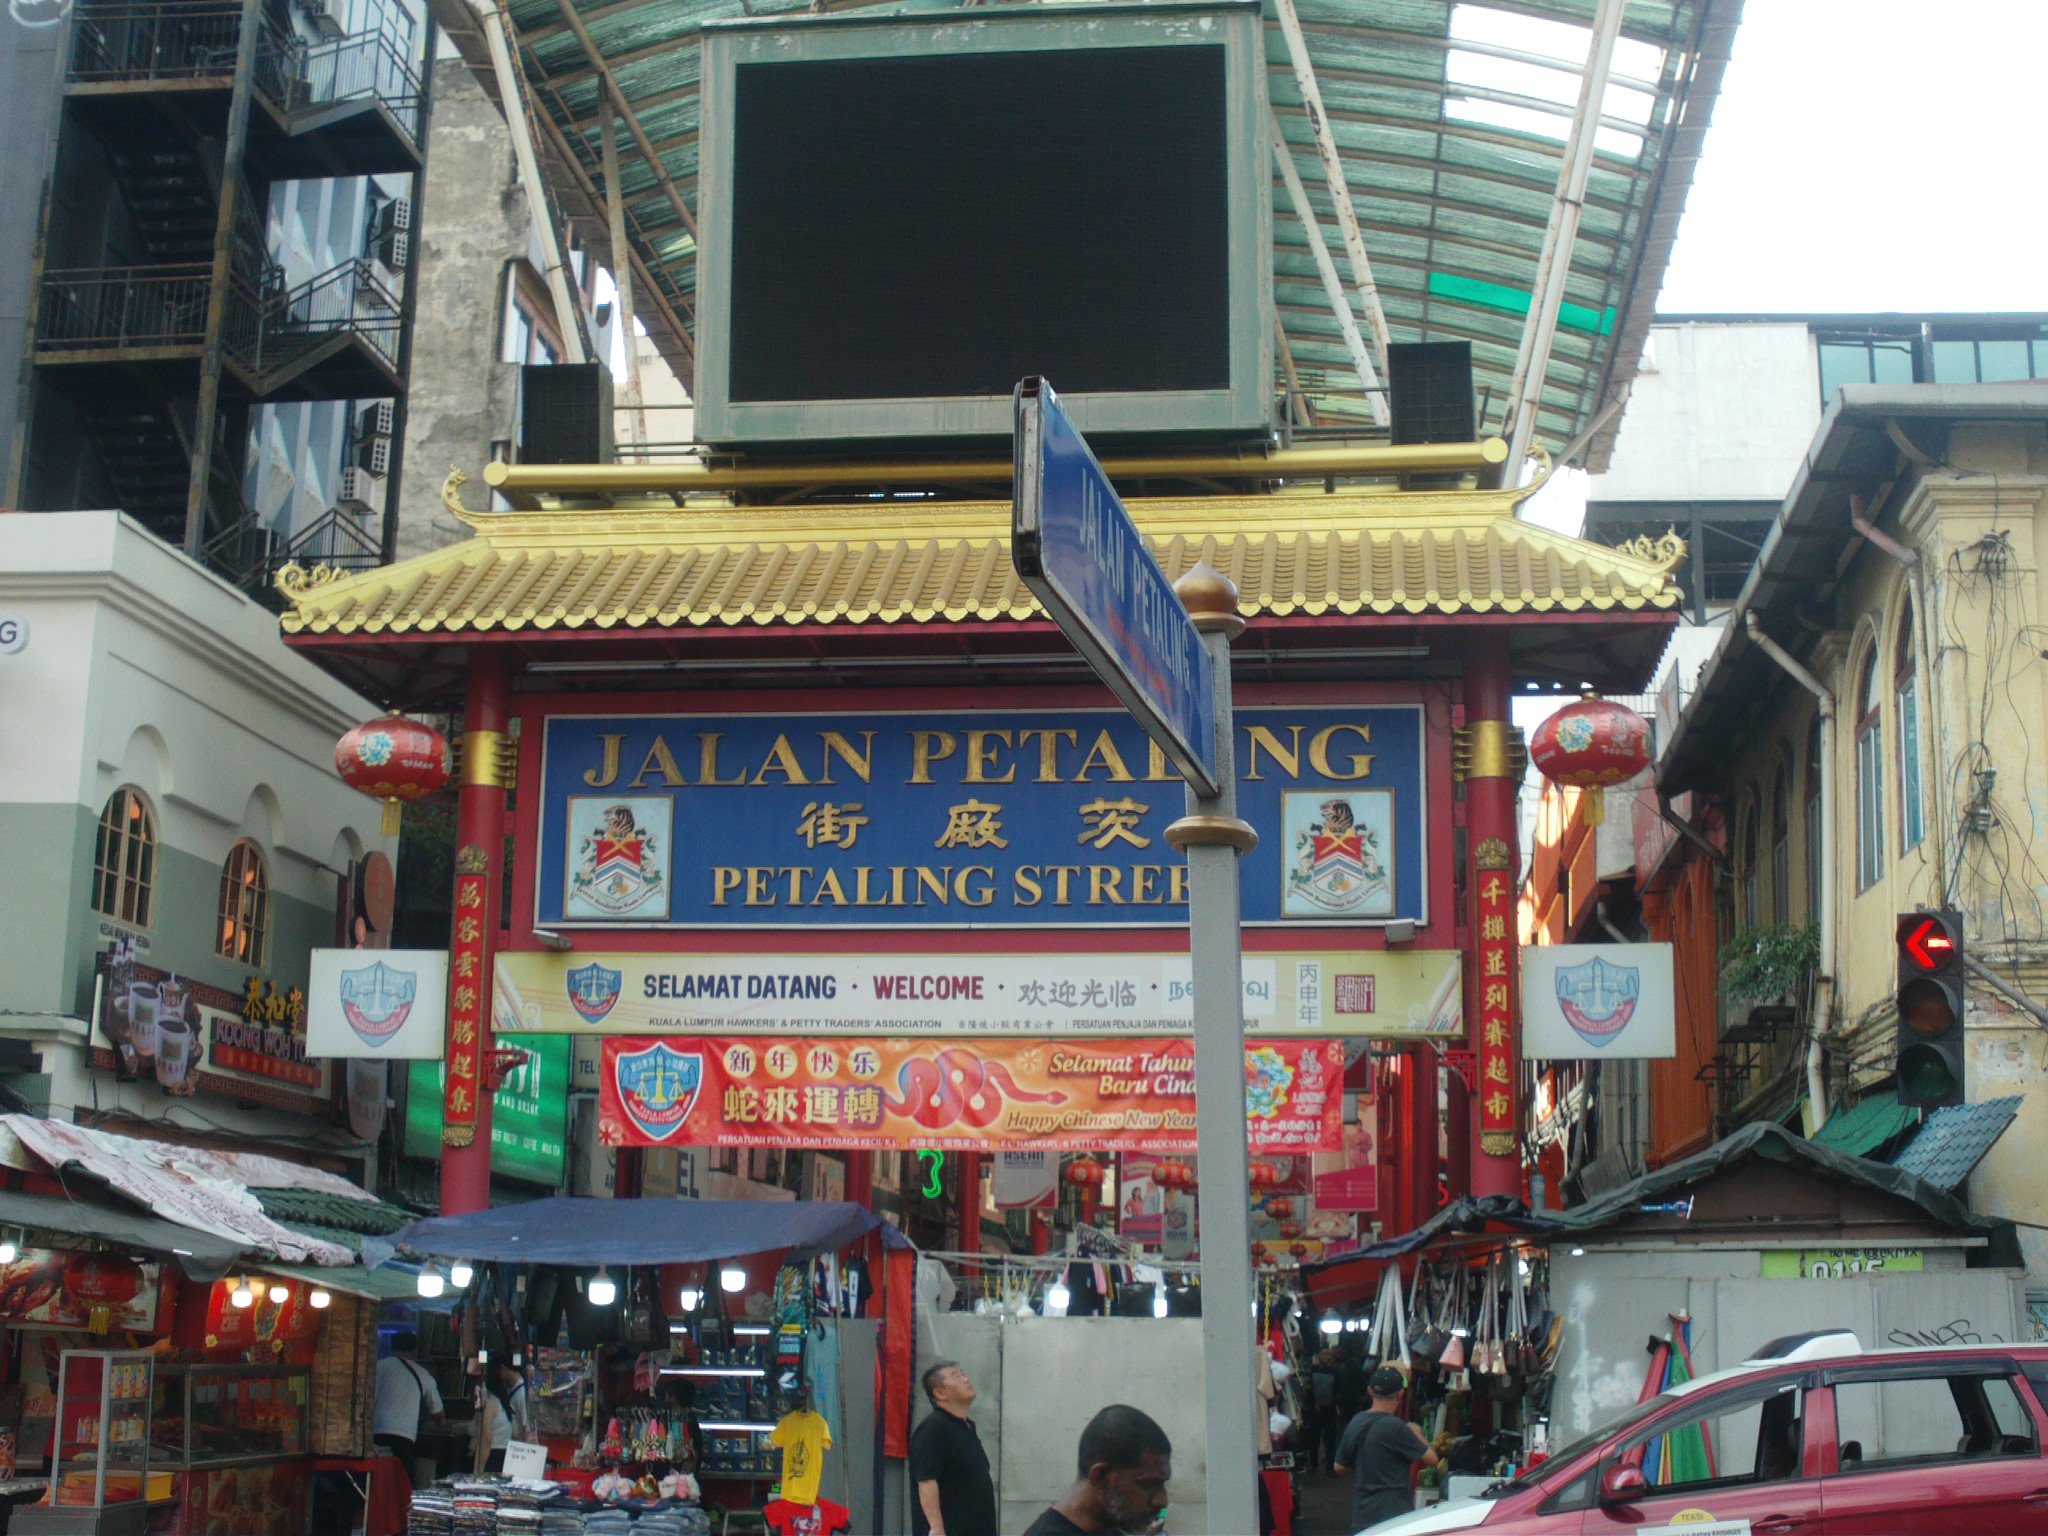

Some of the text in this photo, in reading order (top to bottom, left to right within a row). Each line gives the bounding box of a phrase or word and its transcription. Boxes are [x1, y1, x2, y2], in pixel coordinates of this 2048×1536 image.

[1080, 468, 1126, 602] JALAN
[1133, 548, 1191, 692] PETALING
[582, 723, 1377, 789] JALAN PETALNG
[709, 864, 1190, 907] PETALING STREE
[643, 974, 743, 999] SELAMAT
[747, 974, 837, 999] DATANG
[872, 974, 984, 1000] WELCOME
[1017, 977, 1138, 1008] 欢迎光临
[1298, 963, 1319, 1025] 丙申年
[649, 1017, 682, 1027] KUALA
[683, 1017, 724, 1027] LUMPUR
[781, 1019, 788, 1027] &
[790, 1018, 822, 1028] PETTY
[875, 1019, 942, 1029] ASSOCIATION
[1072, 1018, 1112, 1029] PERSATUAN
[1112, 1018, 1141, 1029] PENJAJA
[1142, 1019, 1157, 1029] DAN
[728, 1050, 876, 1074] 新年快乐
[1050, 1052, 1133, 1074] Selamat
[1099, 1073, 1197, 1095] Baru Cina
[723, 1084, 881, 1125] 蛇來運轉
[1007, 1111, 1058, 1131] Happy
[1062, 1110, 1122, 1129] Chinese
[1125, 1111, 1162, 1128] New
[718, 1134, 766, 1145] PERSATUAN
[767, 1135, 801, 1146] PENJAJA
[803, 1136, 821, 1146] DAN
[823, 1136, 859, 1147] PENIAGA
[1069, 1139, 1097, 1149] PETTY
[1141, 1139, 1198, 1149] ASSOCIATION
[1681, 1513, 1704, 1521] TEKSI
